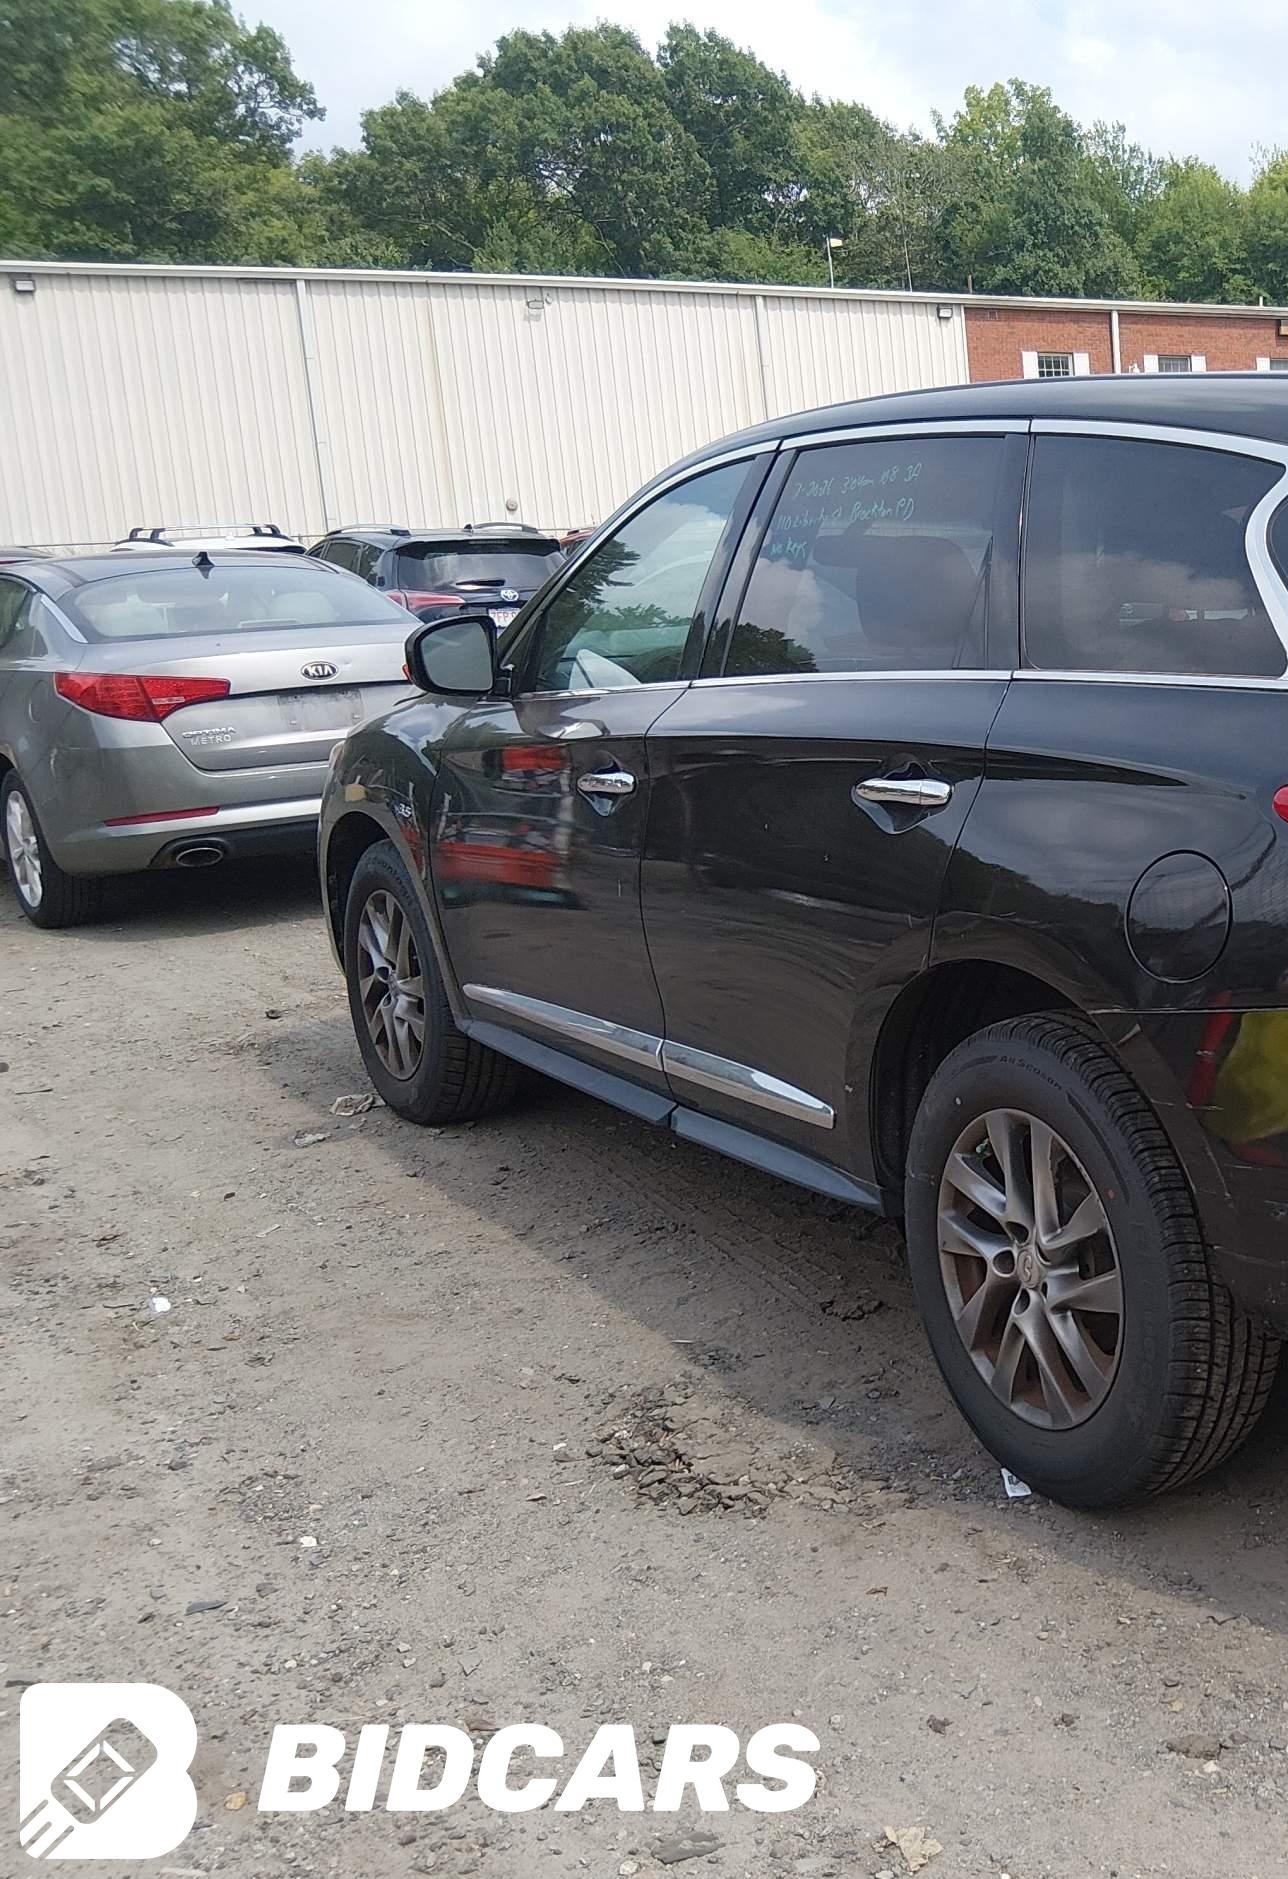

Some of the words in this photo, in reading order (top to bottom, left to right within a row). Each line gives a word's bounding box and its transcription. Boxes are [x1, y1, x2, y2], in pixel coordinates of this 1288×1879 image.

[308, 664, 334, 677] KIA
[182, 726, 237, 739] OPTIMA
[190, 734, 232, 746] METRO
